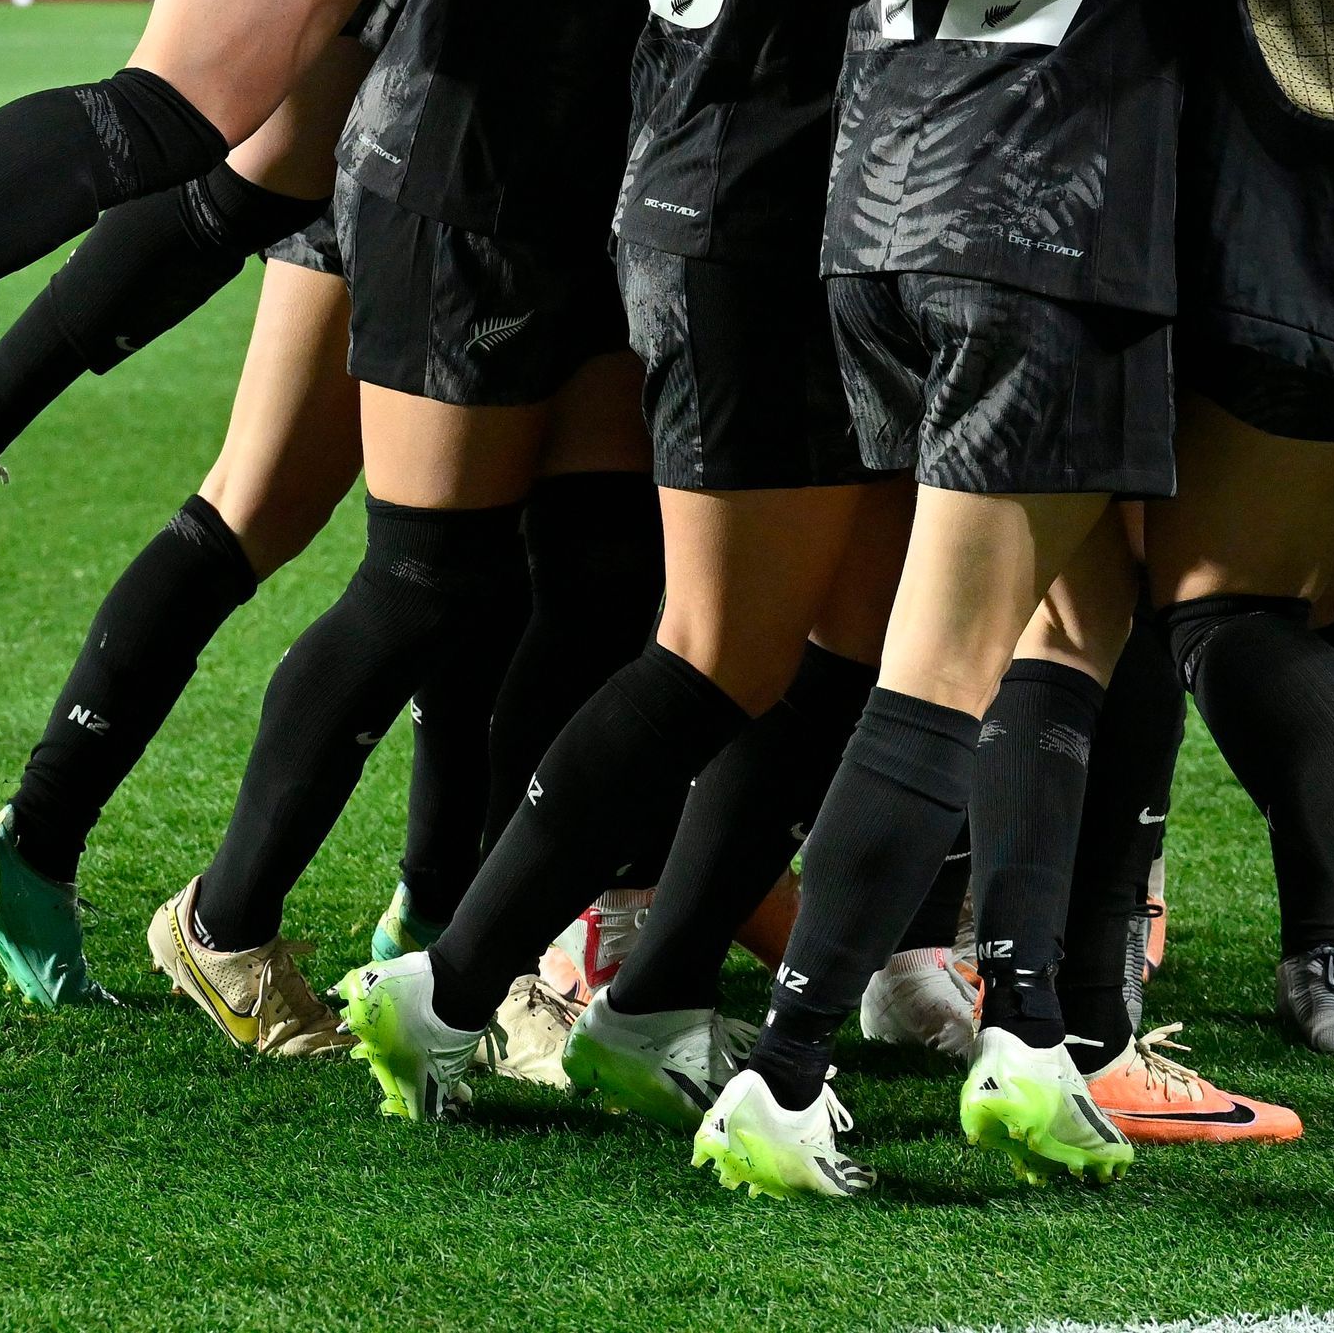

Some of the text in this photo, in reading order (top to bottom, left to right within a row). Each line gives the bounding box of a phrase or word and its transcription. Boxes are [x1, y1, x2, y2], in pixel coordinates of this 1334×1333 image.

[67, 704, 111, 736] NZ
[978, 939, 1014, 961] NZ
[776, 962, 810, 994] NZ
